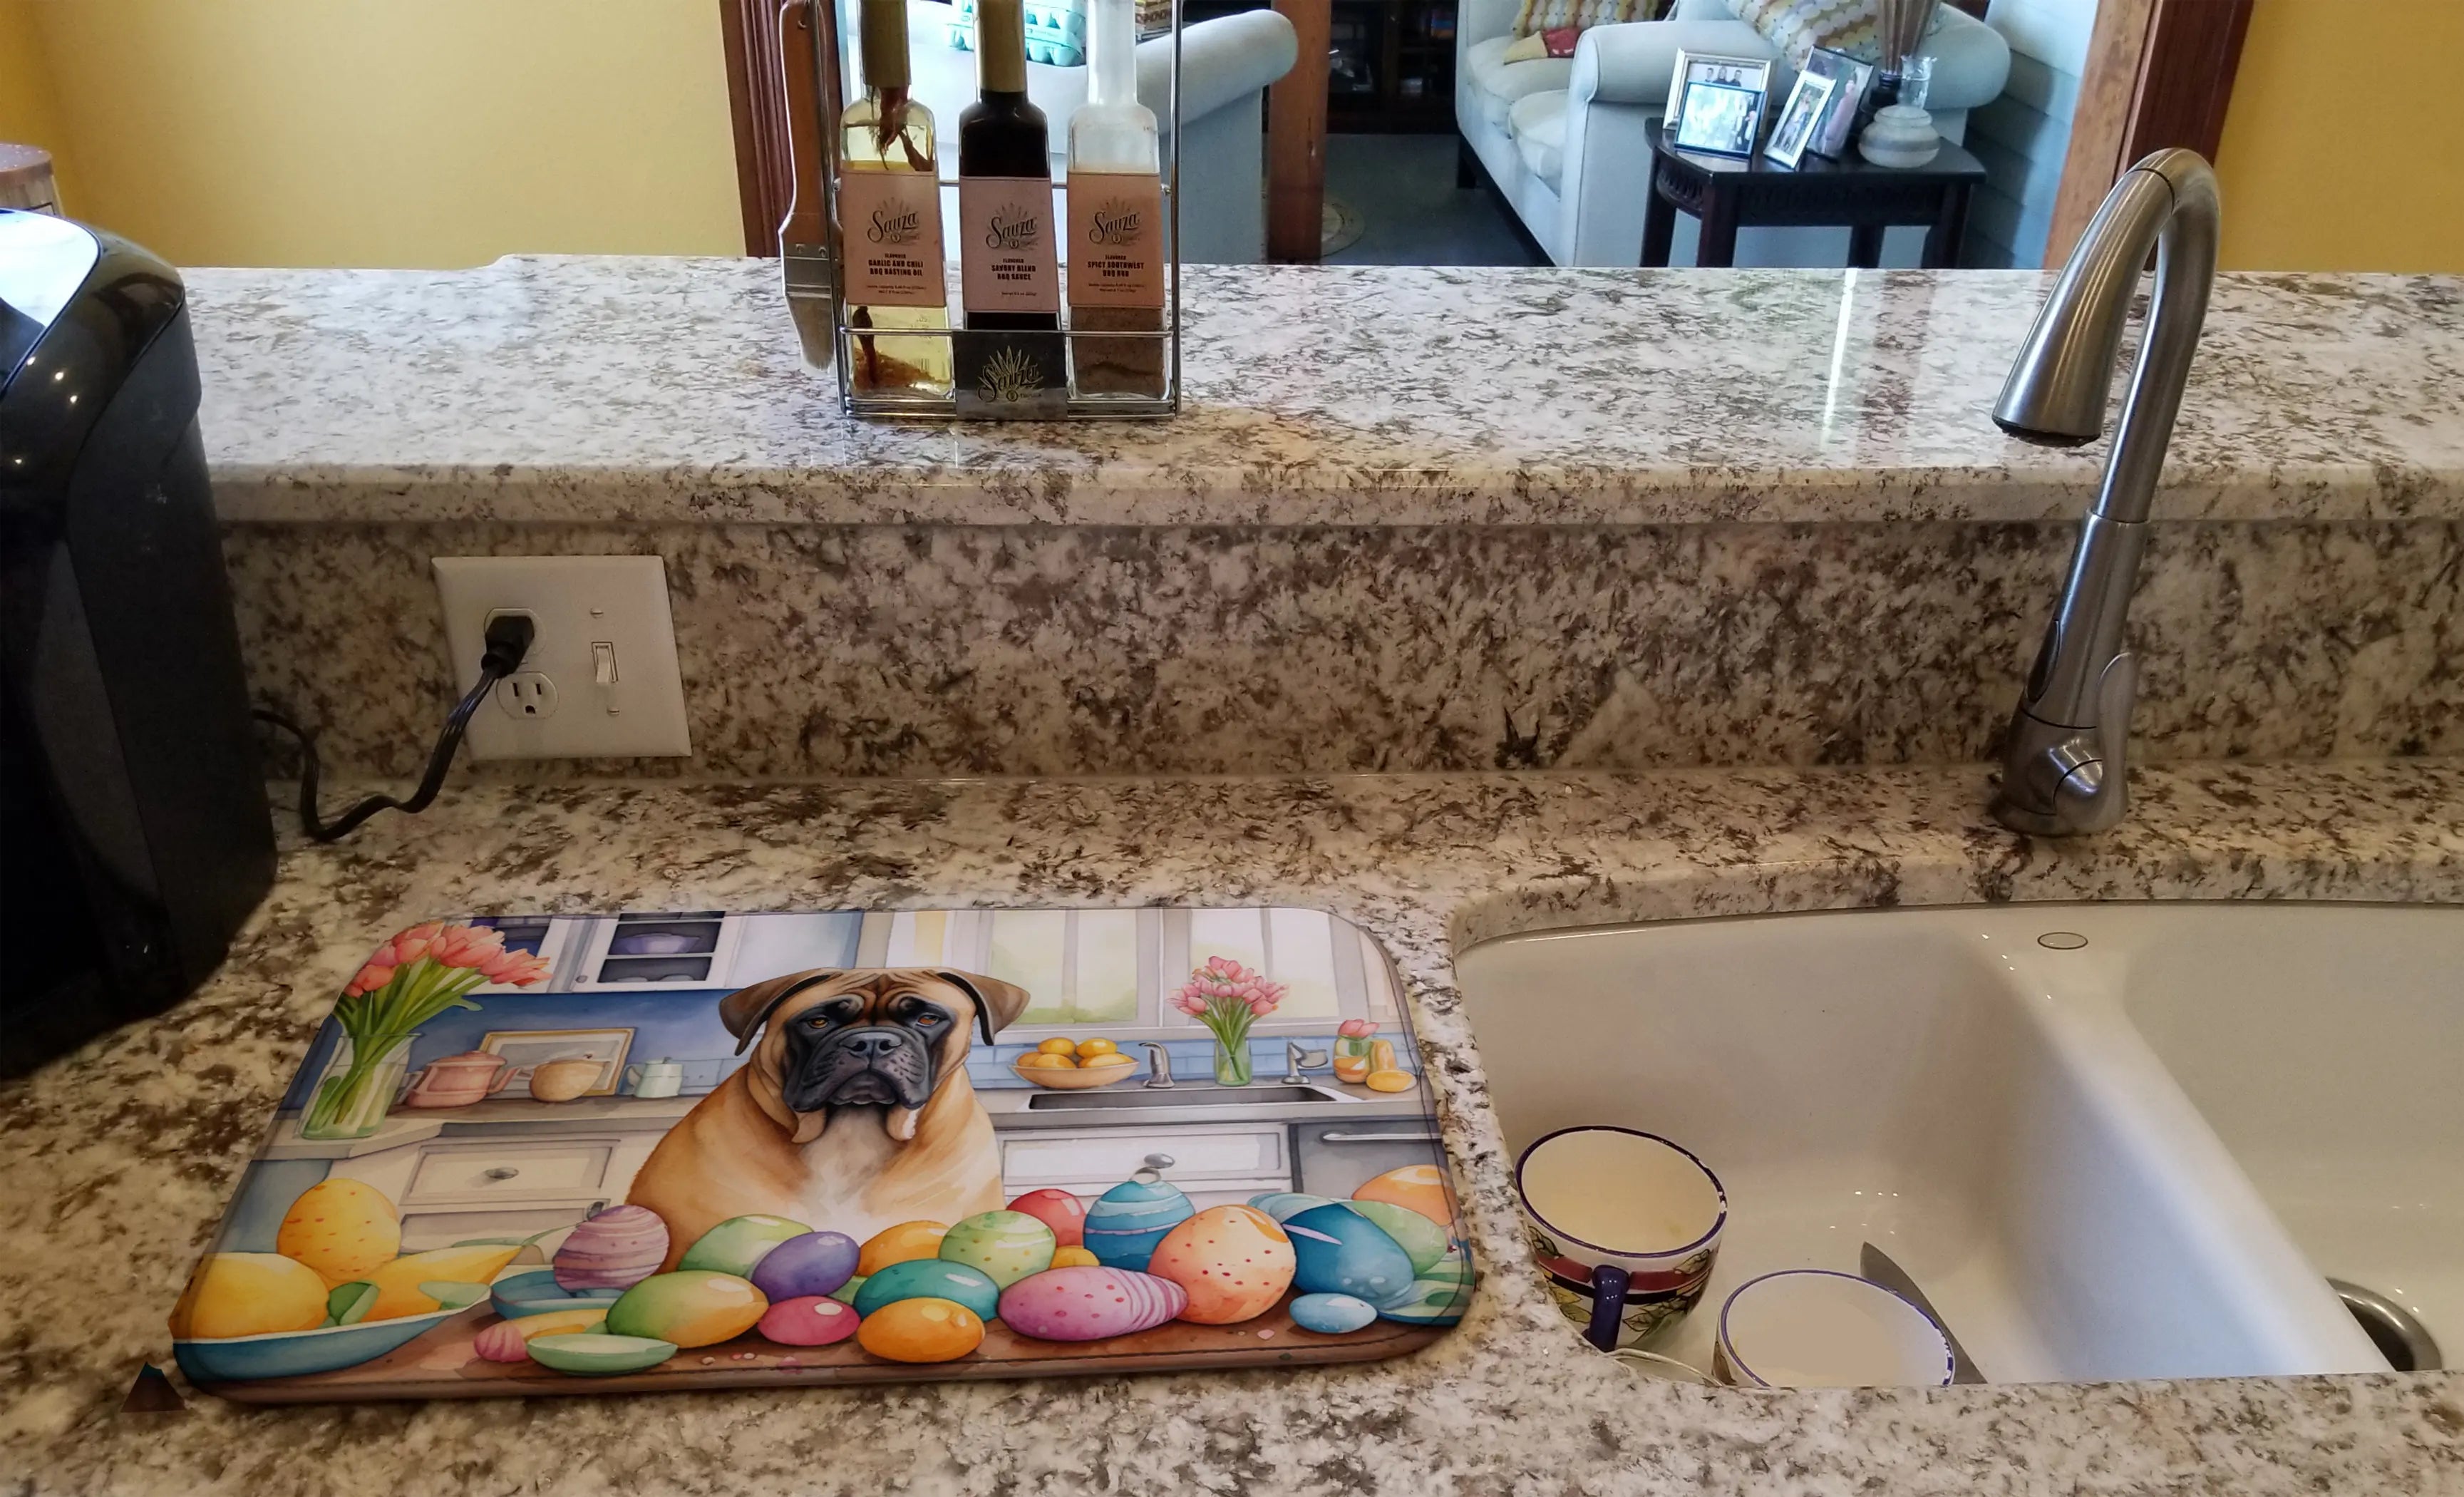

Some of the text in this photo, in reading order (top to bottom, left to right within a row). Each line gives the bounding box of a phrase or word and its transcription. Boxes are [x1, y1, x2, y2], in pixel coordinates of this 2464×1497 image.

[867, 210, 919, 242] Sauza
[986, 216, 1038, 249] Sauza
[1089, 211, 1140, 243] Sauza
[978, 364, 1040, 403] Sauza
